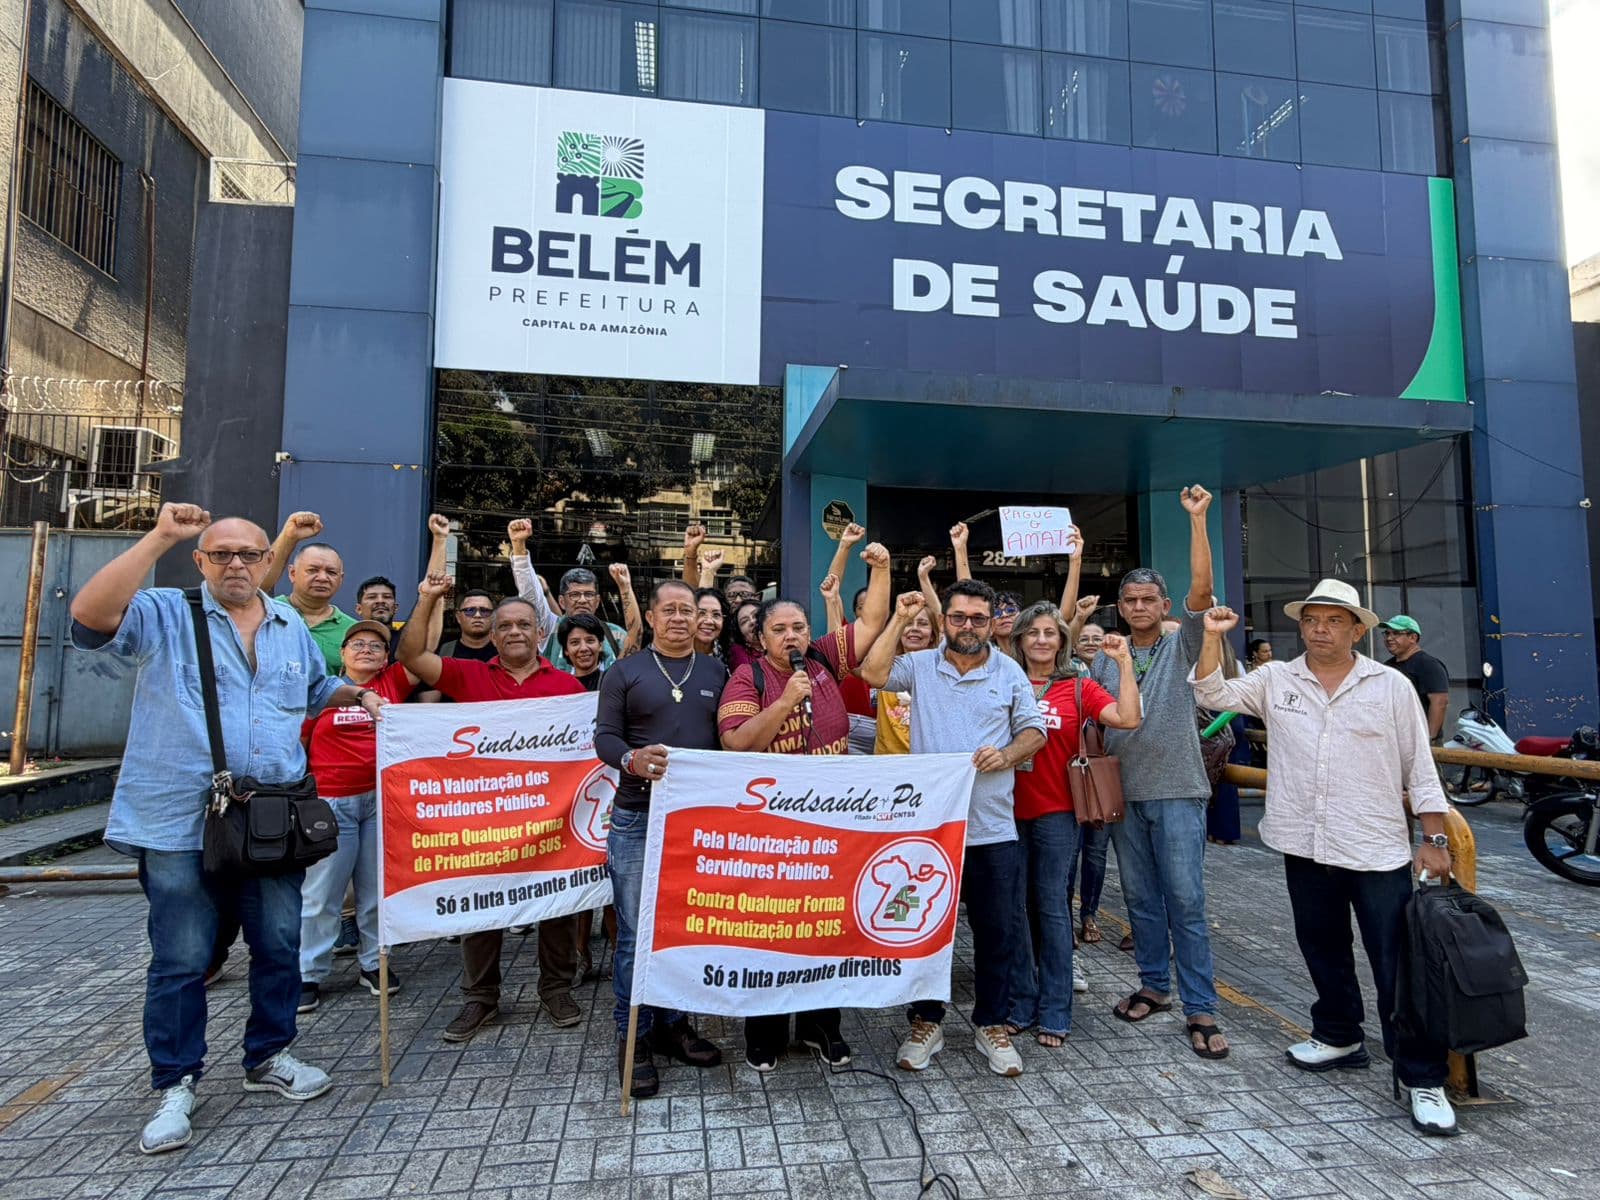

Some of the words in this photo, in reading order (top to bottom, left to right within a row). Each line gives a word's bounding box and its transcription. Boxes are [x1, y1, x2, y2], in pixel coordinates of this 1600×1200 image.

[835, 165, 1343, 260] SECRETARIA
[491, 226, 701, 288] BELÉM
[489, 286, 700, 316] PREFEITURA
[893, 258, 999, 317] DE
[1033, 255, 1298, 339] SAÚDE
[522, 318, 576, 331] CAPITAL
[579, 323, 597, 332] DA
[600, 322, 668, 336] AMAZÔNIA
[1002, 508, 1053, 520] PAGUE
[982, 551, 1026, 567] 2821
[446, 724, 579, 758] Sindsaúde
[410, 778, 441, 796] Pela
[443, 773, 523, 794] Valorização
[526, 771, 550, 785] dos
[735, 777, 878, 812] Sindsaúde
[891, 783, 923, 811] Pa
[416, 799, 493, 819] Servidores
[496, 793, 551, 814] Público.
[412, 831, 459, 849] Contra
[462, 825, 523, 846] Qualquer
[526, 816, 564, 835] Forma
[693, 828, 724, 849] Pela
[727, 831, 810, 858] Valorização
[813, 836, 838, 855] dos
[414, 857, 432, 873] de
[435, 847, 519, 871] Privatização
[521, 843, 537, 858] do
[539, 837, 567, 854] SUS.
[696, 856, 774, 879] Servidores
[777, 861, 834, 881] Público.
[436, 895, 456, 916] Só
[461, 897, 470, 913] a
[474, 890, 504, 911] luta
[509, 874, 566, 906] garante
[687, 887, 735, 910] Contra
[738, 891, 801, 914] Qualquer
[803, 895, 846, 912] Forma
[686, 914, 704, 933] de
[708, 916, 793, 942] Privatização
[796, 920, 812, 938] do
[815, 919, 846, 937] SUS.
[703, 964, 724, 988] Só
[728, 971, 738, 988] a
[742, 967, 773, 989] luta
[776, 966, 836, 988] garante
[838, 957, 901, 978] direitos
